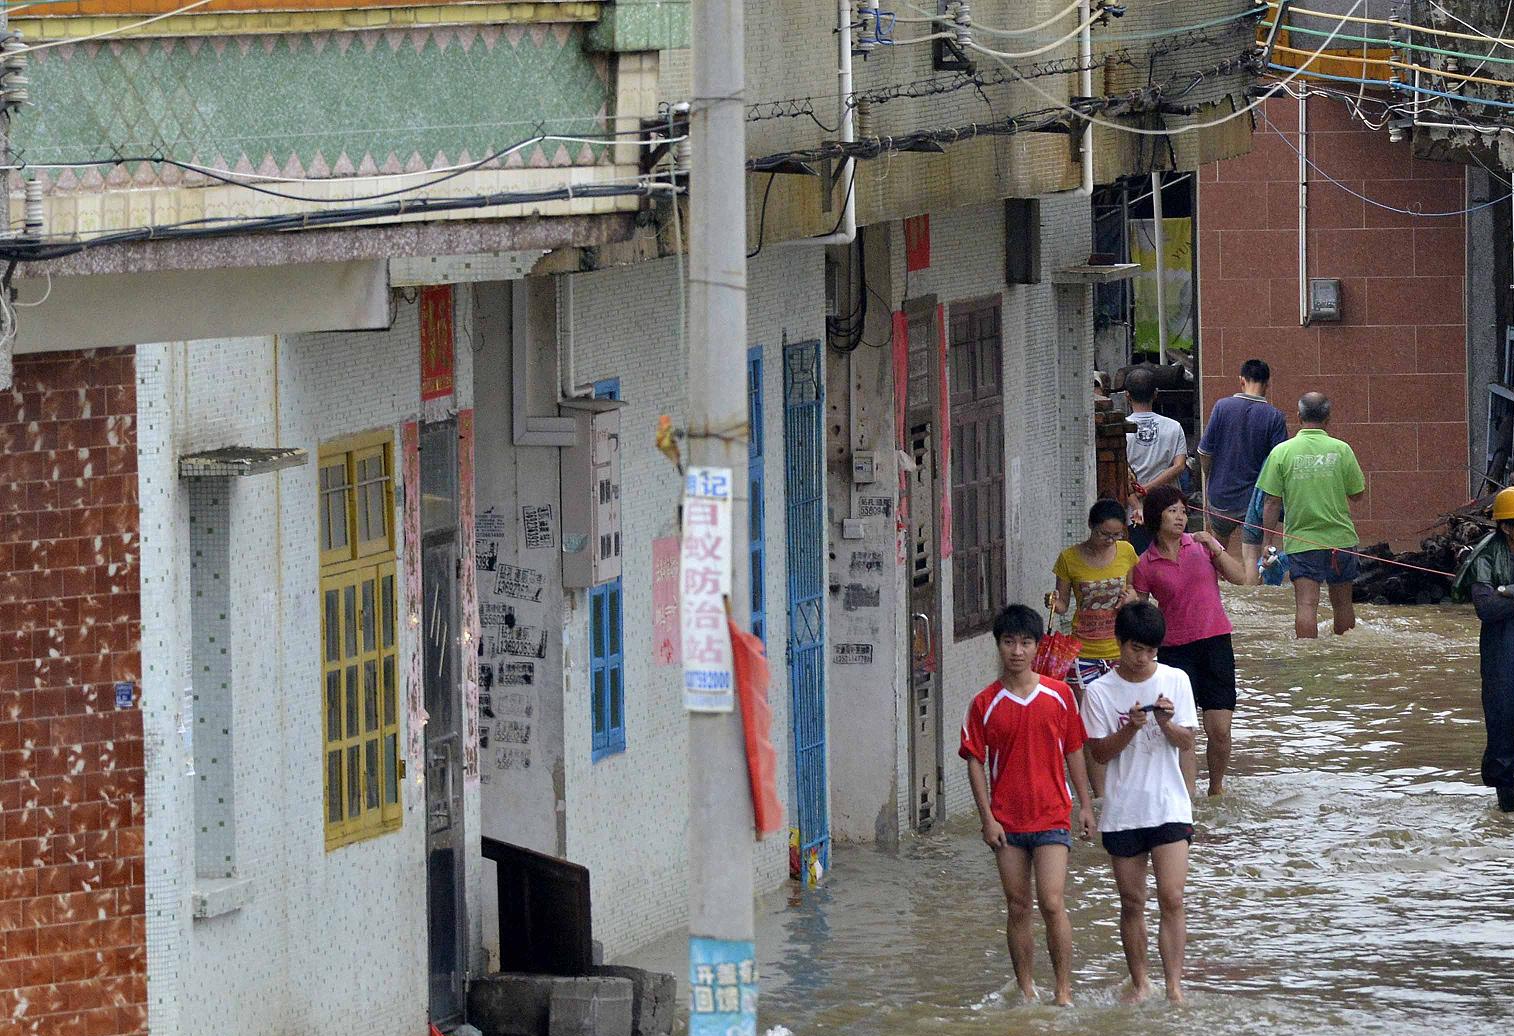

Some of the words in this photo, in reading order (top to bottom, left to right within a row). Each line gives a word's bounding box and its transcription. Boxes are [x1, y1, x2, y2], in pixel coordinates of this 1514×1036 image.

[684, 499, 723, 664] 白蚁防治站
